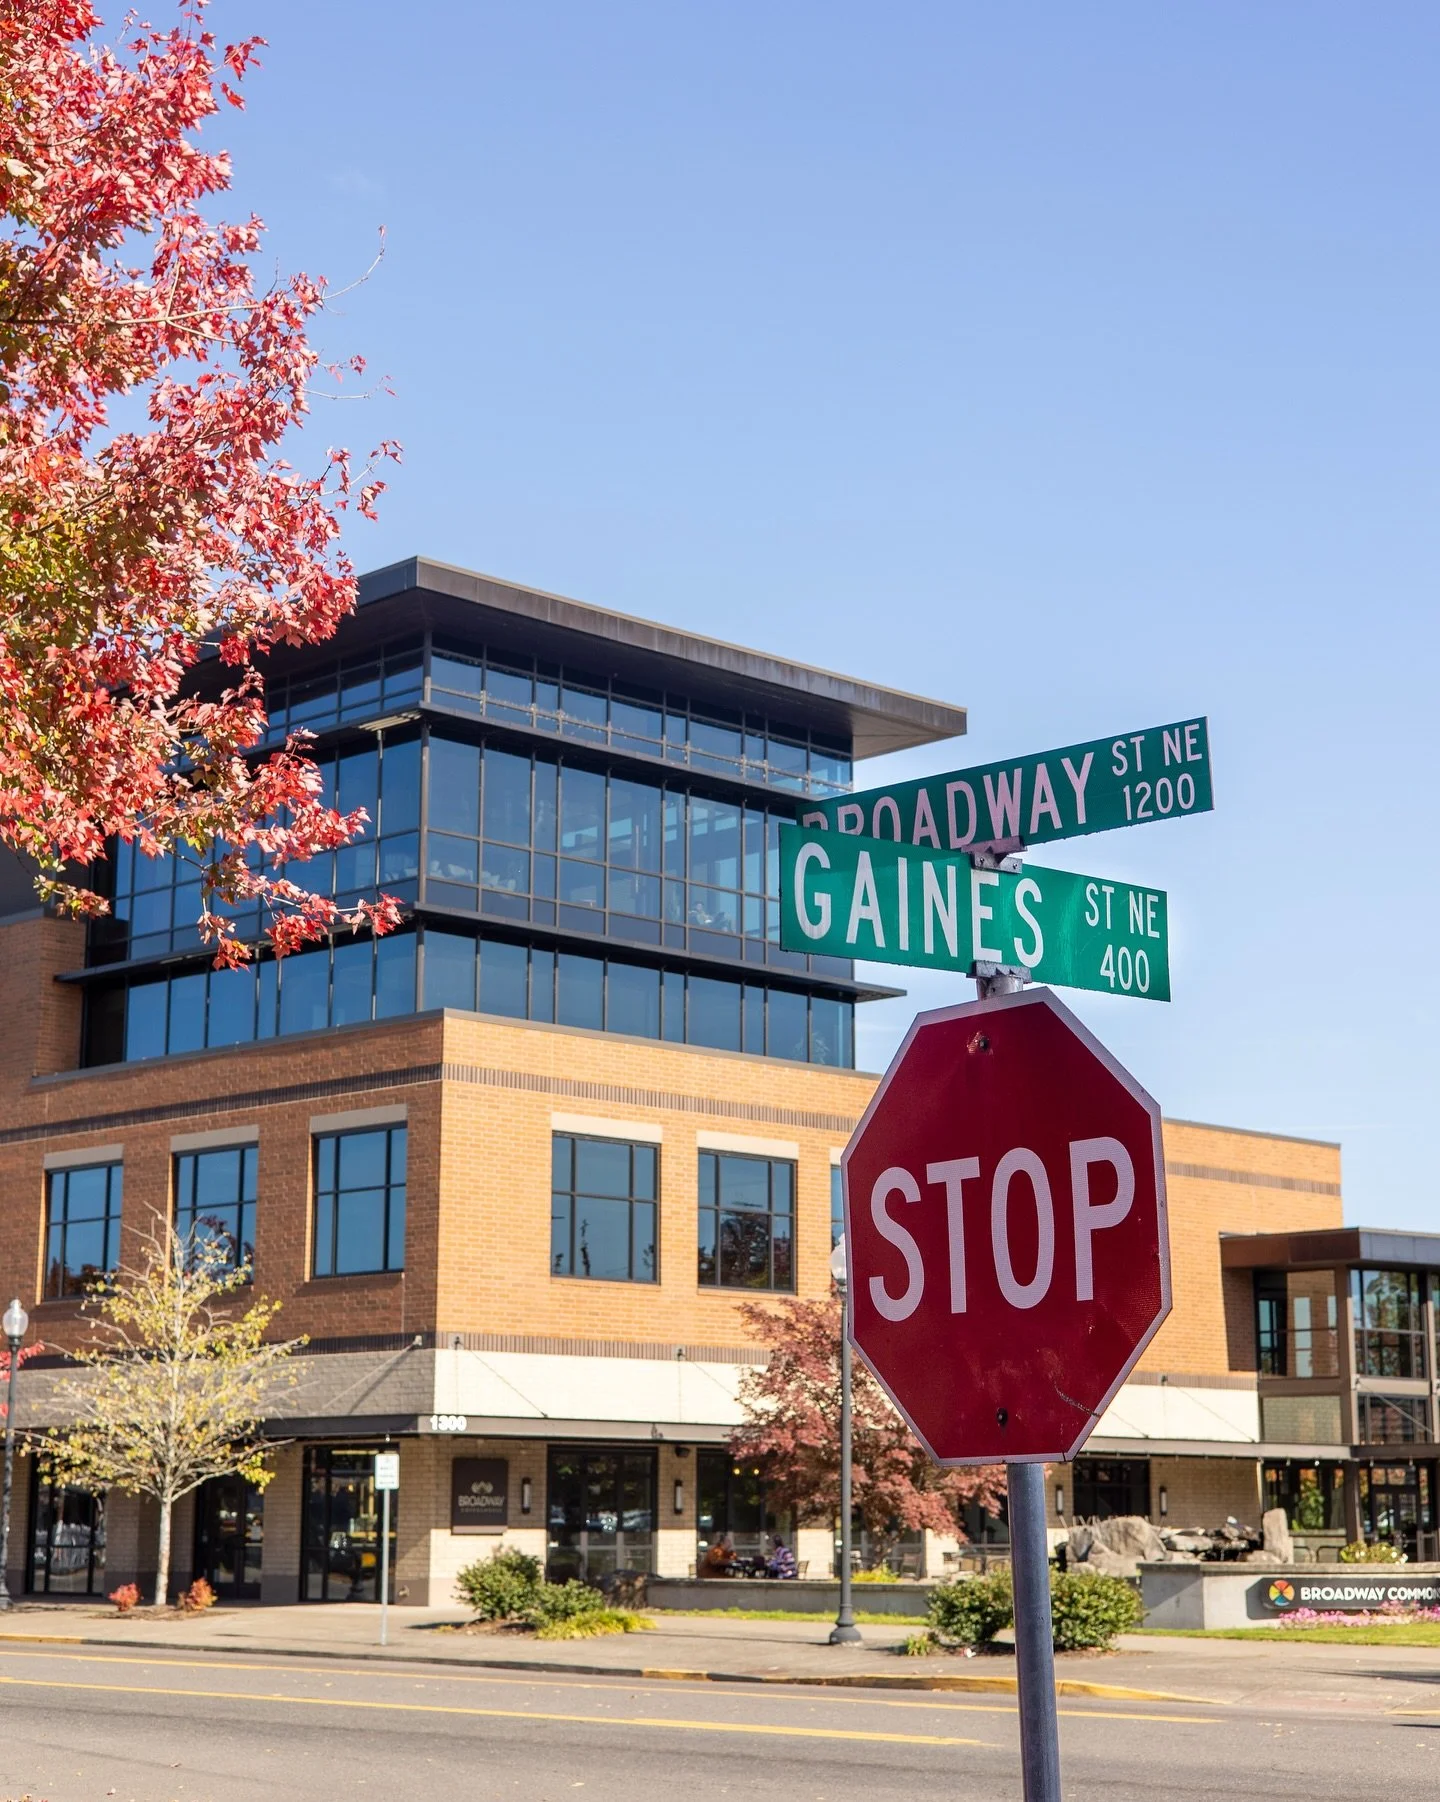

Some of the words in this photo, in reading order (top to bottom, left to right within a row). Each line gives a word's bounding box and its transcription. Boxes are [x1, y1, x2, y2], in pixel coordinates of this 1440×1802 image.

[1111, 736, 1145, 776] ST
[1163, 724, 1202, 766] NE
[1123, 773, 1195, 821] 1200
[794, 842, 1043, 968] GAINES
[1085, 883, 1115, 930] ST
[1129, 890, 1160, 938] NE
[1100, 944, 1150, 993] 400
[869, 1136, 1135, 1322] STOP
[458, 1495, 505, 1507] BROADWAY
[1300, 1587, 1385, 1600] BROADWAY
